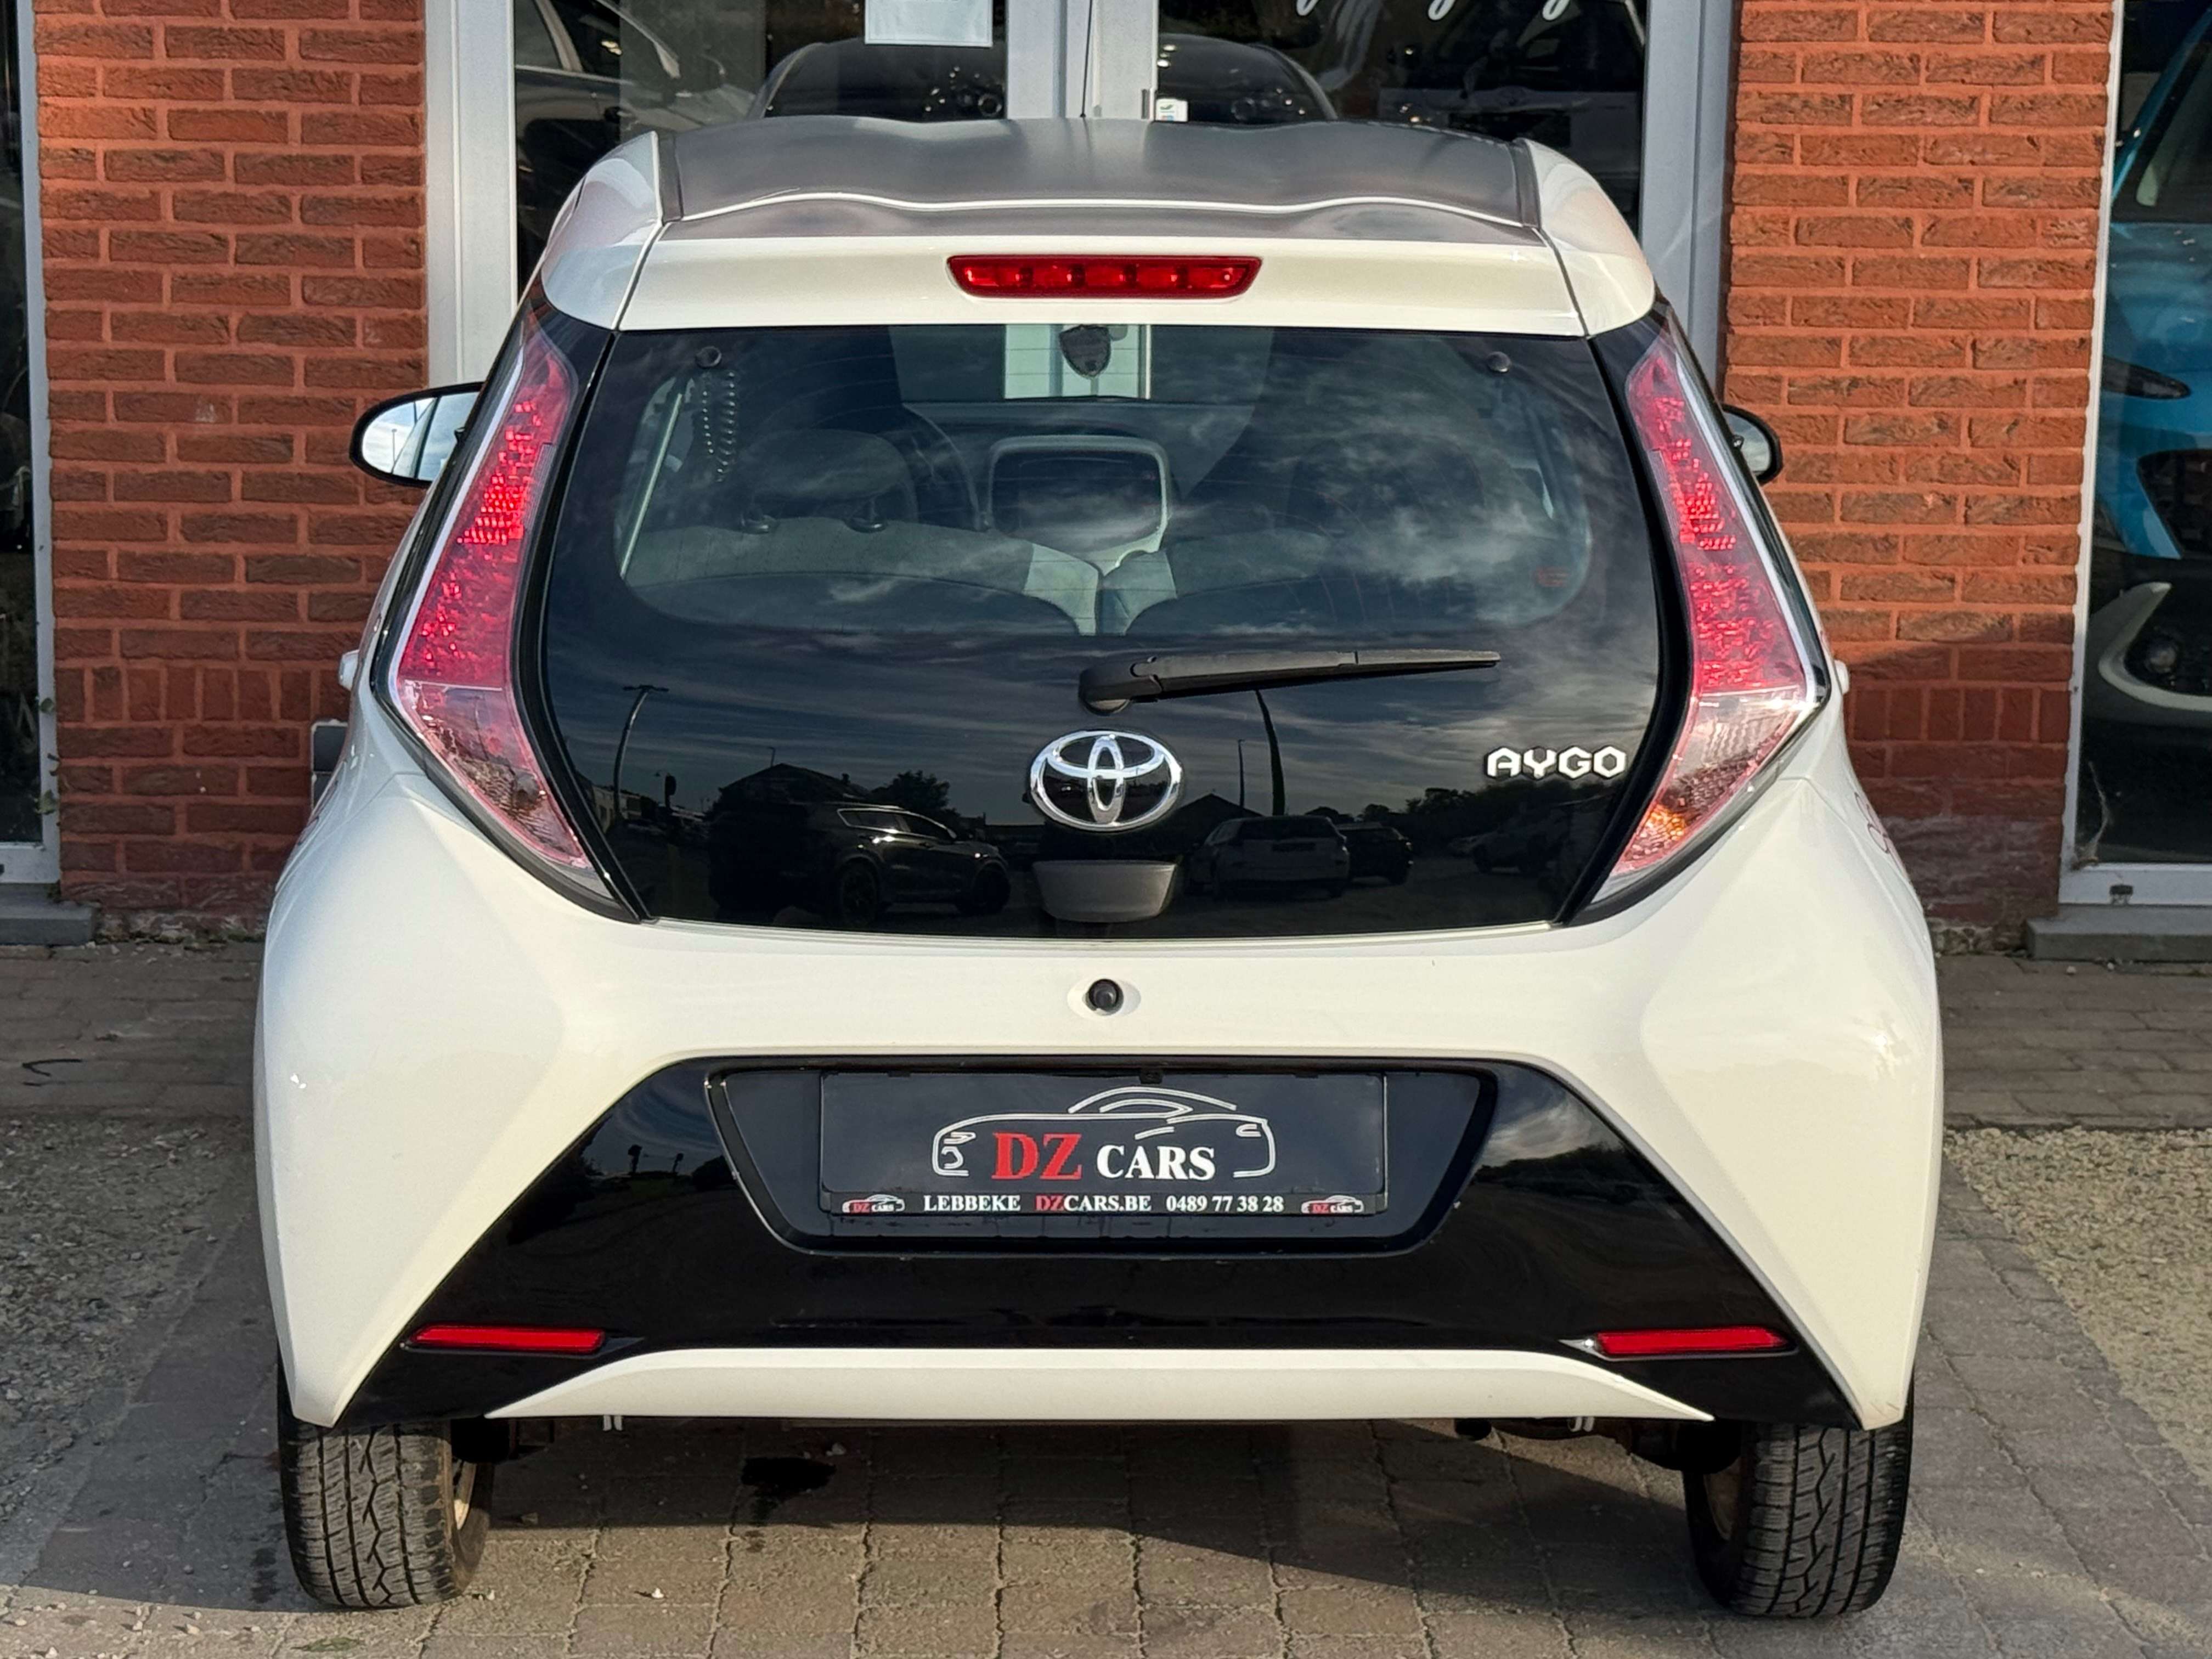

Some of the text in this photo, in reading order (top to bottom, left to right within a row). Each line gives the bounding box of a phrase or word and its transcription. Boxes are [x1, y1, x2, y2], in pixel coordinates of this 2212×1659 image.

[1486, 746, 1627, 779] AYGO
[991, 1132, 1216, 1181] DZ CARS
[923, 1194, 1285, 1212] LEBBEKE DZCARS.BE 0489 77 38 28
